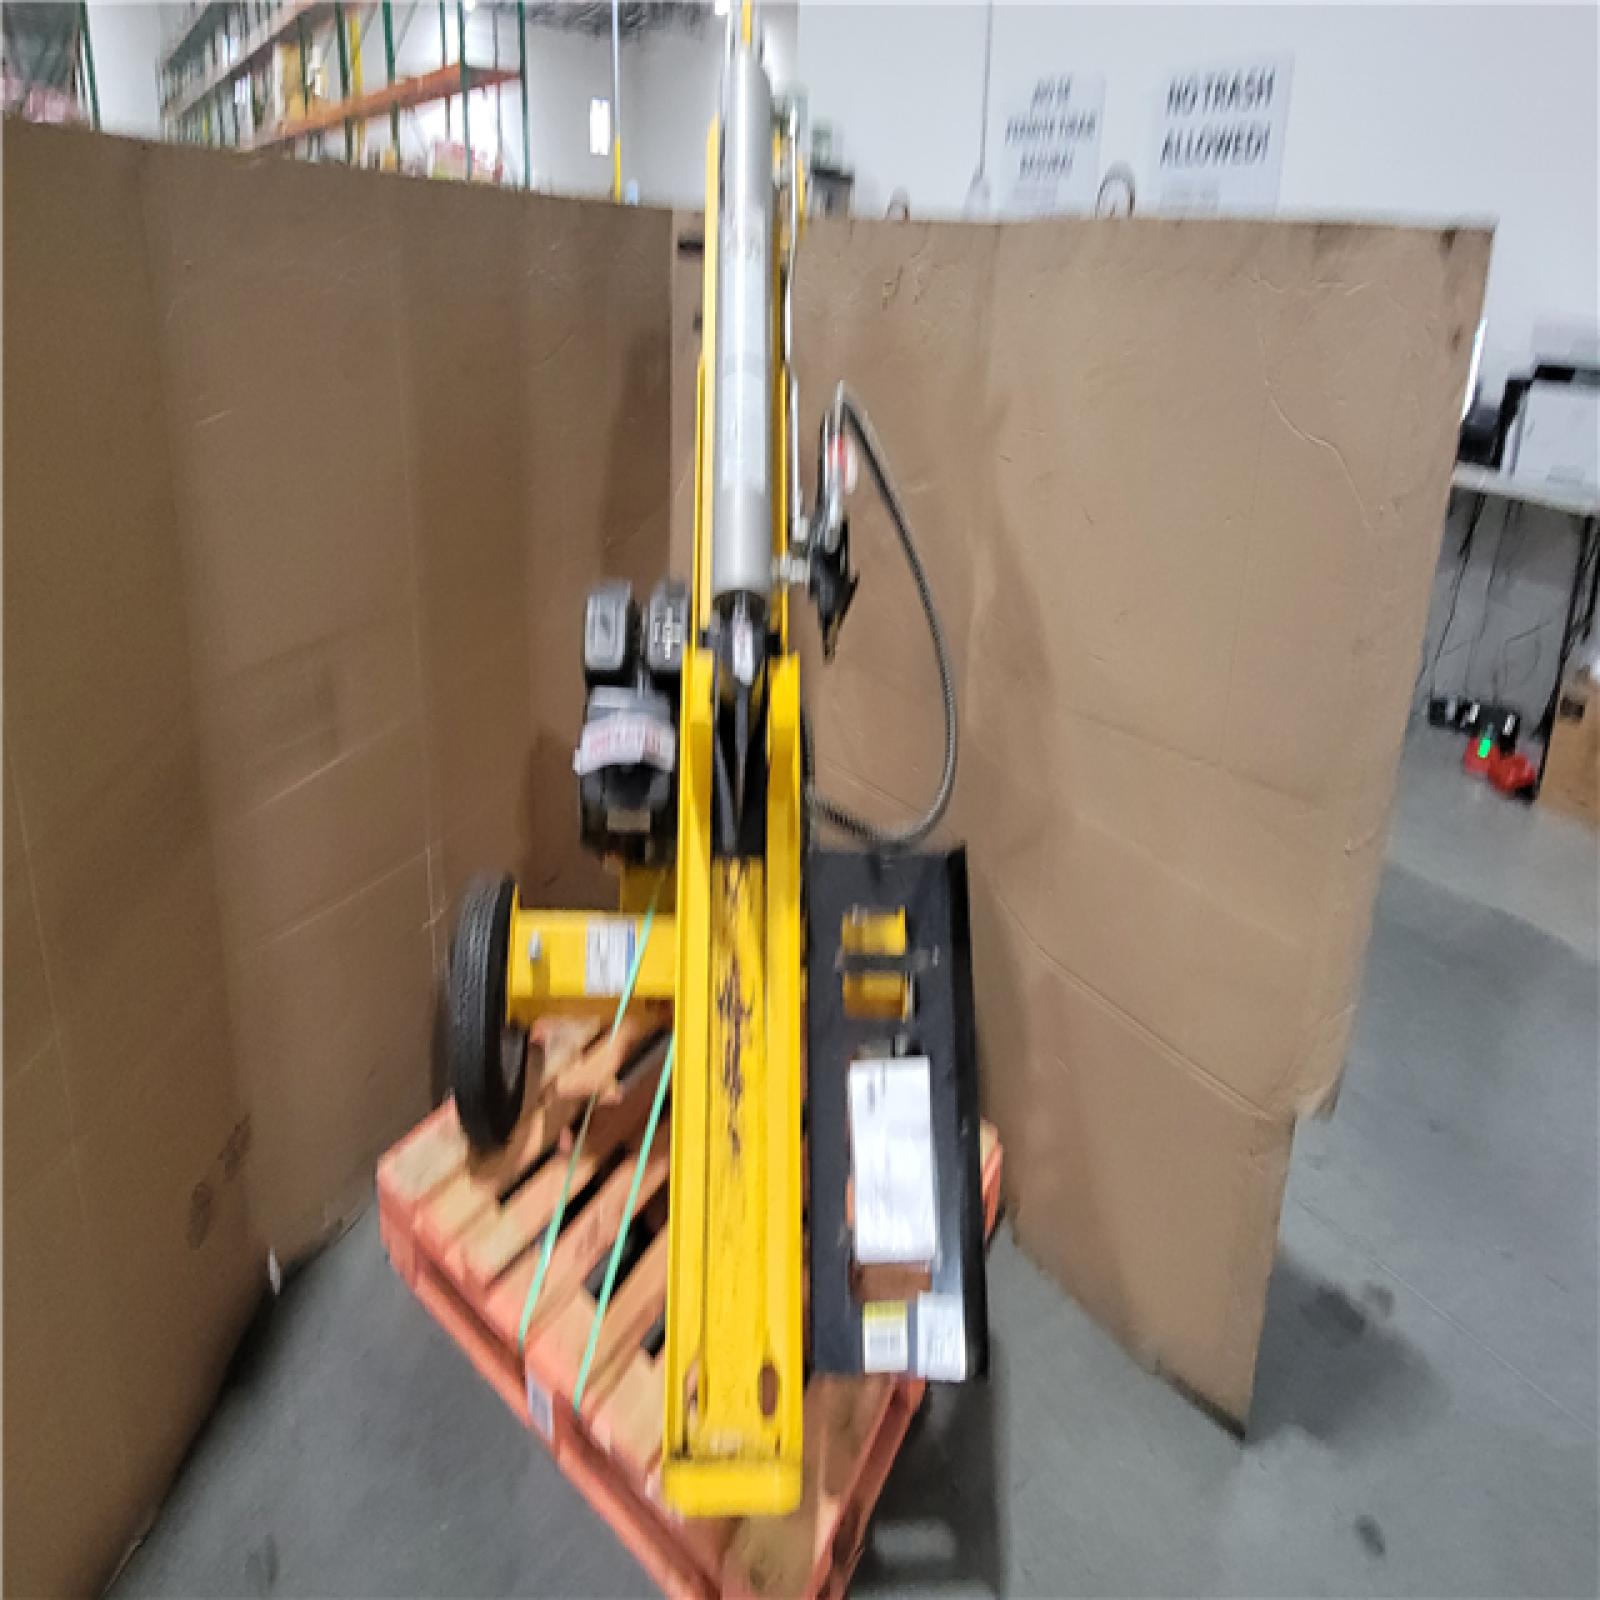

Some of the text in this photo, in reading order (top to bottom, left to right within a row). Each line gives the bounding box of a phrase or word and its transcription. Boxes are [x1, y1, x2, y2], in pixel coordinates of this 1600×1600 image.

[1166, 65, 1276, 116] NO TRASH
[1160, 122, 1271, 167] ALLOWED!
